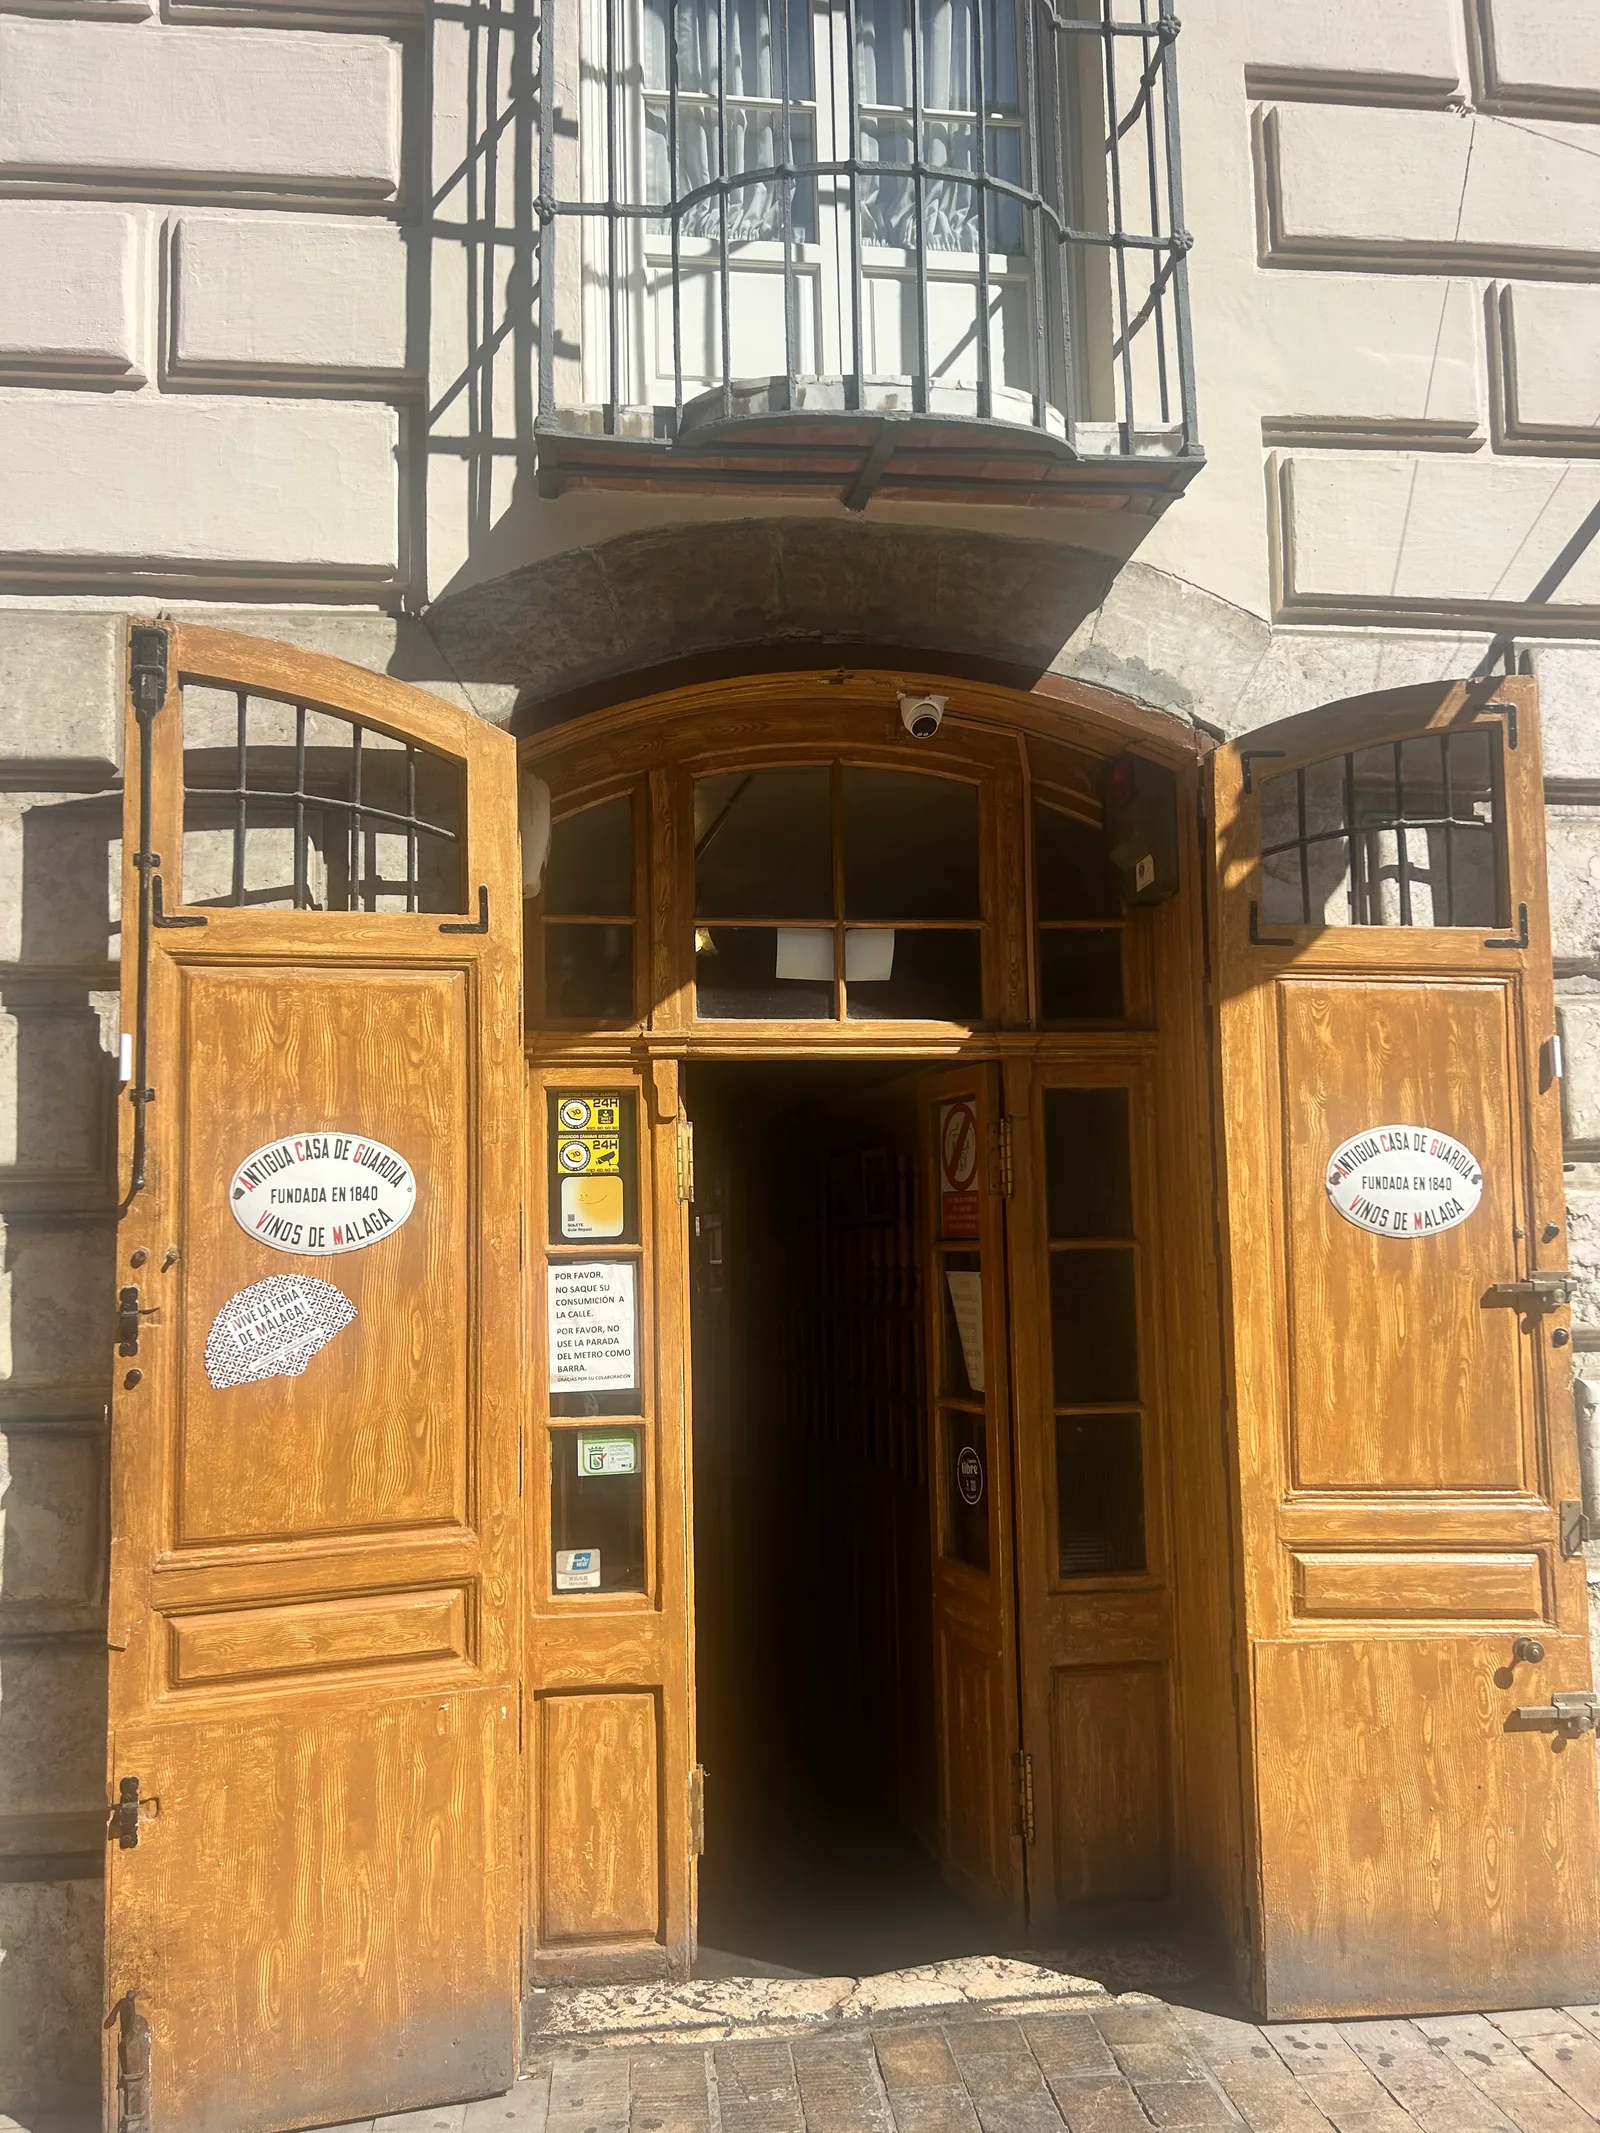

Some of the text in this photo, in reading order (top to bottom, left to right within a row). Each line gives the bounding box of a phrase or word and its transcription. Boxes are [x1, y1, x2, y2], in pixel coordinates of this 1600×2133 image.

[593, 1098, 618, 1108] 24H
[593, 1140, 618, 1149] 24H
[1334, 1132, 1475, 1180] ANTIGUA CASA DE GUARDIA
[238, 1138, 407, 1192] ANTIGUA CASA DE GUARDIA
[1362, 1176, 1452, 1191] FUNDADA EN 1840
[270, 1186, 378, 1204] FUNDADA EN 1840
[1349, 1194, 1465, 1230] VINOS DE MALAGA
[255, 1208, 393, 1248] VINOS DE MALAGA
[574, 1271, 604, 1280] FAVOR,
[570, 1285, 597, 1293] SAQUE
[555, 1295, 614, 1306] CONSUMICIÓN
[232, 1289, 300, 1332] ¡VIVE LA FERIA
[568, 1310, 594, 1318] CALLE.
[575, 1326, 605, 1334] FAVOR,
[238, 1329, 256, 1346] DE
[586, 1338, 620, 1346] PARADA
[574, 1351, 603, 1359] METRO
[605, 1349, 631, 1357] COMO
[557, 1364, 587, 1373] BARRA.
[961, 1461, 978, 1475] libre
